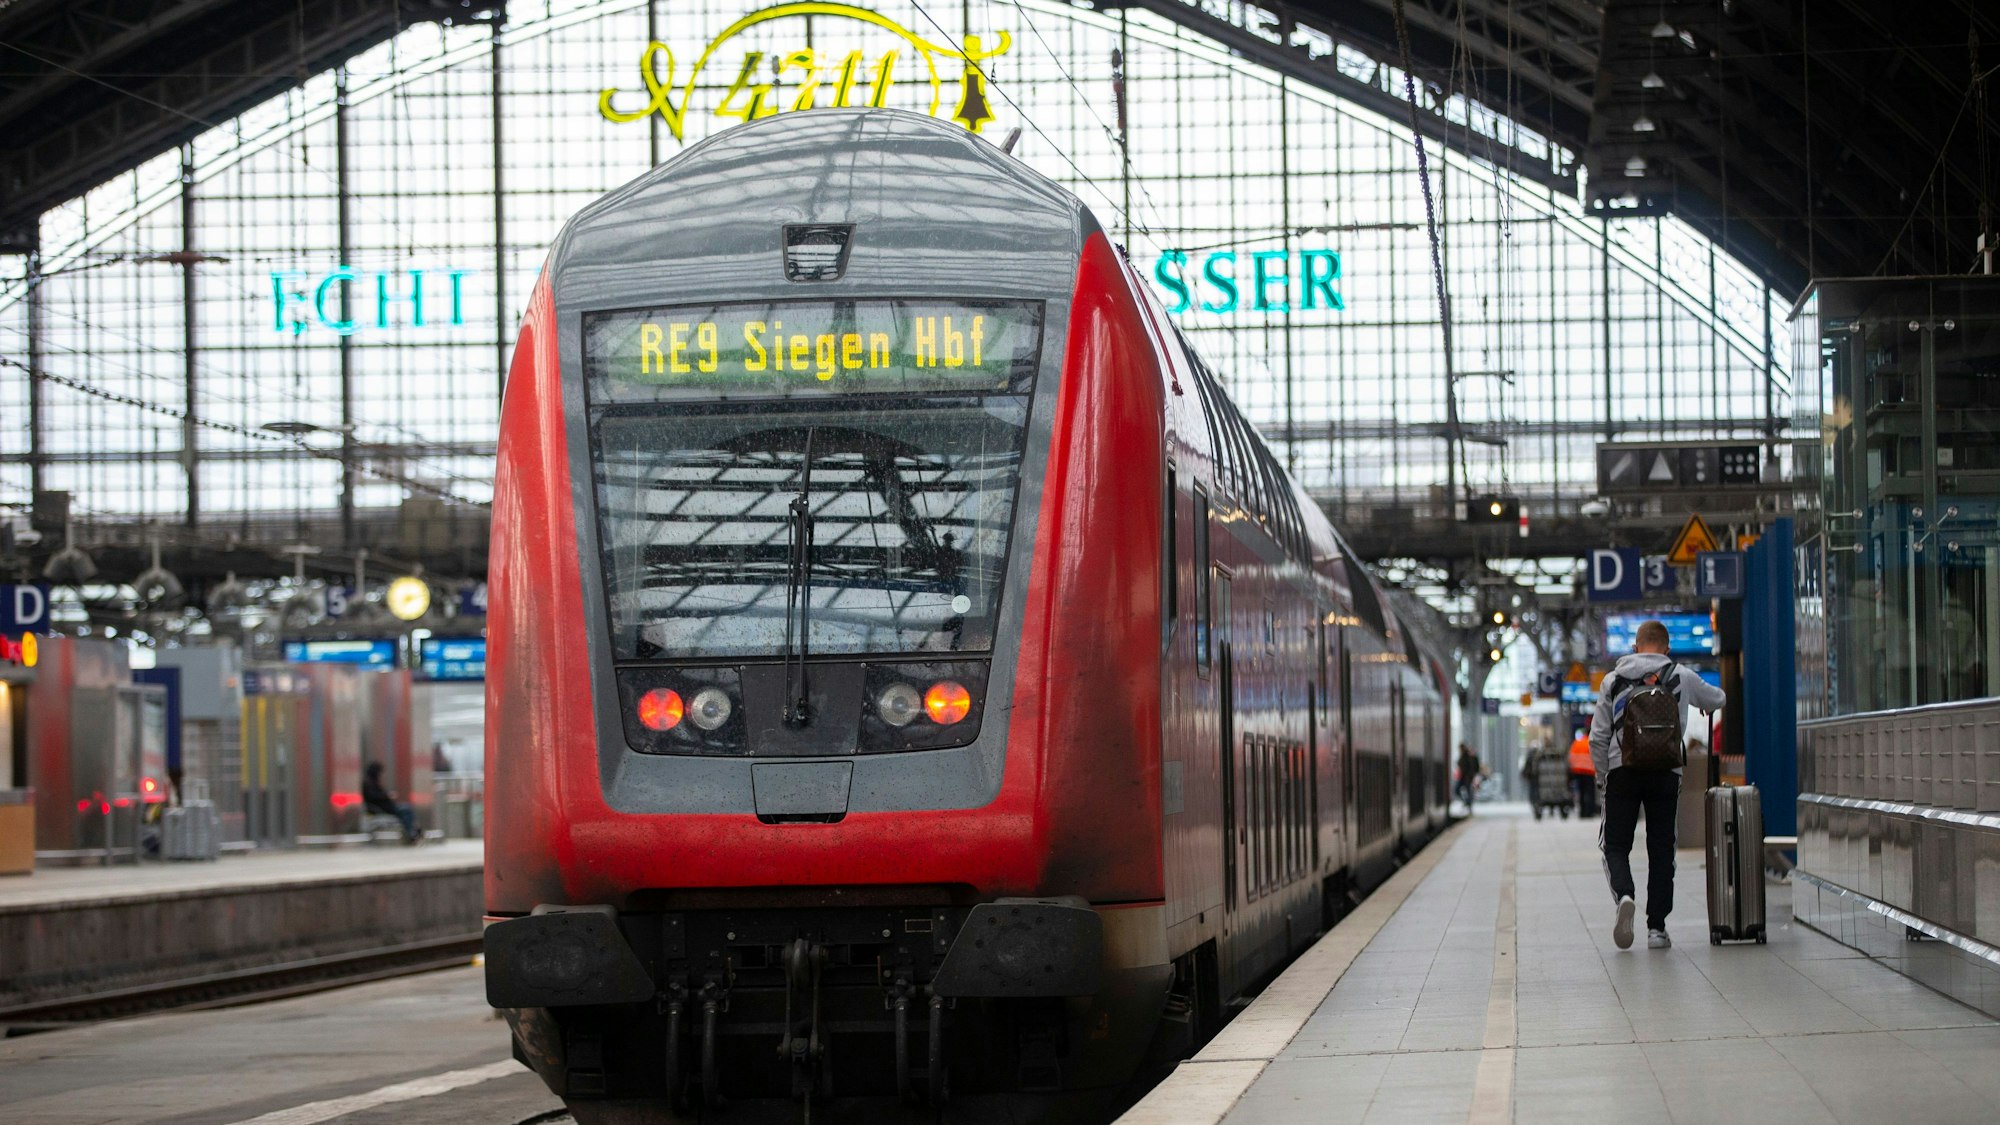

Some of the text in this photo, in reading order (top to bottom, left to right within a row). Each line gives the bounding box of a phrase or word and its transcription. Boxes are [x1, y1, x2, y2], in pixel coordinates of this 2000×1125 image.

[715, 48, 900, 122] 4711
[271, 265, 478, 336] ECHT
[1155, 249, 1344, 314] SSER
[640, 315, 985, 381] RE9 Siegen Hbf
[1593, 549, 1623, 590] D
[1647, 561, 1665, 587] 3
[14, 584, 44, 625] D
[1540, 671, 1558, 693] C
